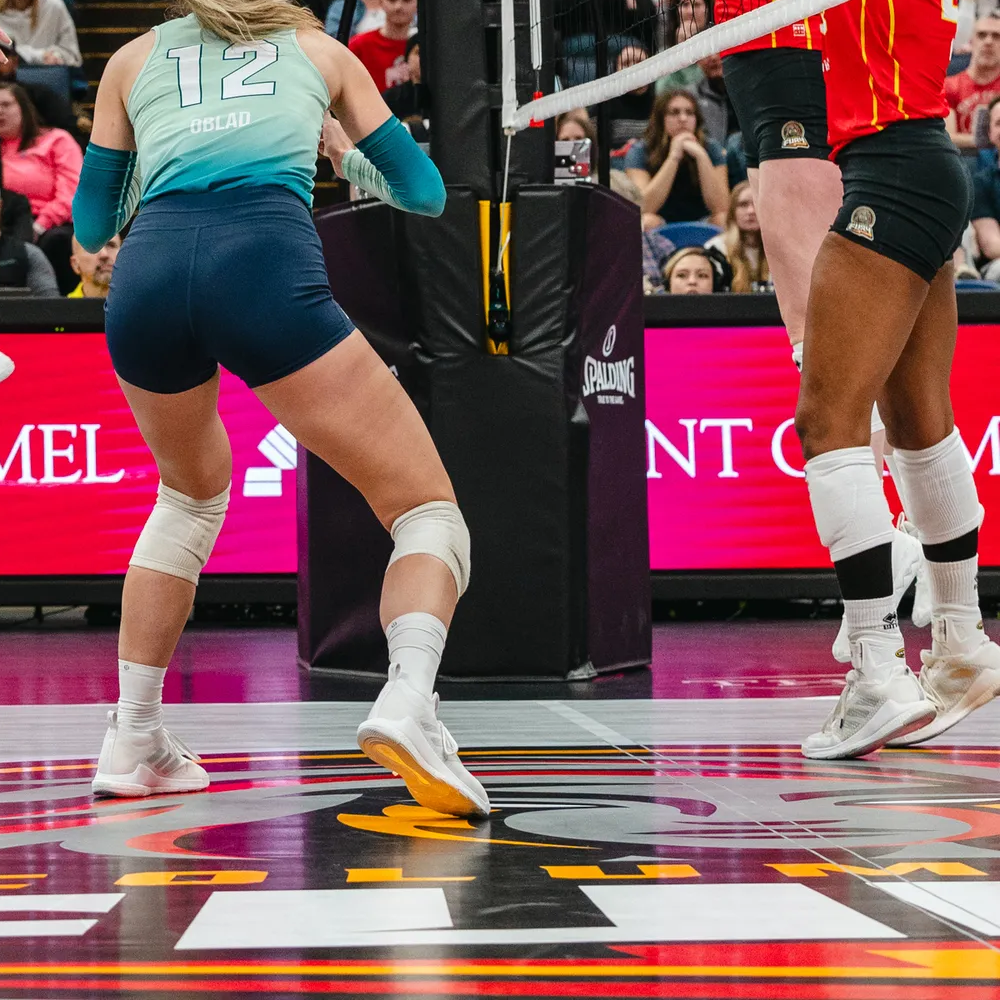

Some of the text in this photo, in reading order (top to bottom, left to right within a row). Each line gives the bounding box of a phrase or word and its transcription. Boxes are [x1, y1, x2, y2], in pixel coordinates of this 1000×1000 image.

[166, 39, 279, 109] 12
[189, 111, 252, 134] OBLAD
[582, 354, 636, 399] SPALDING
